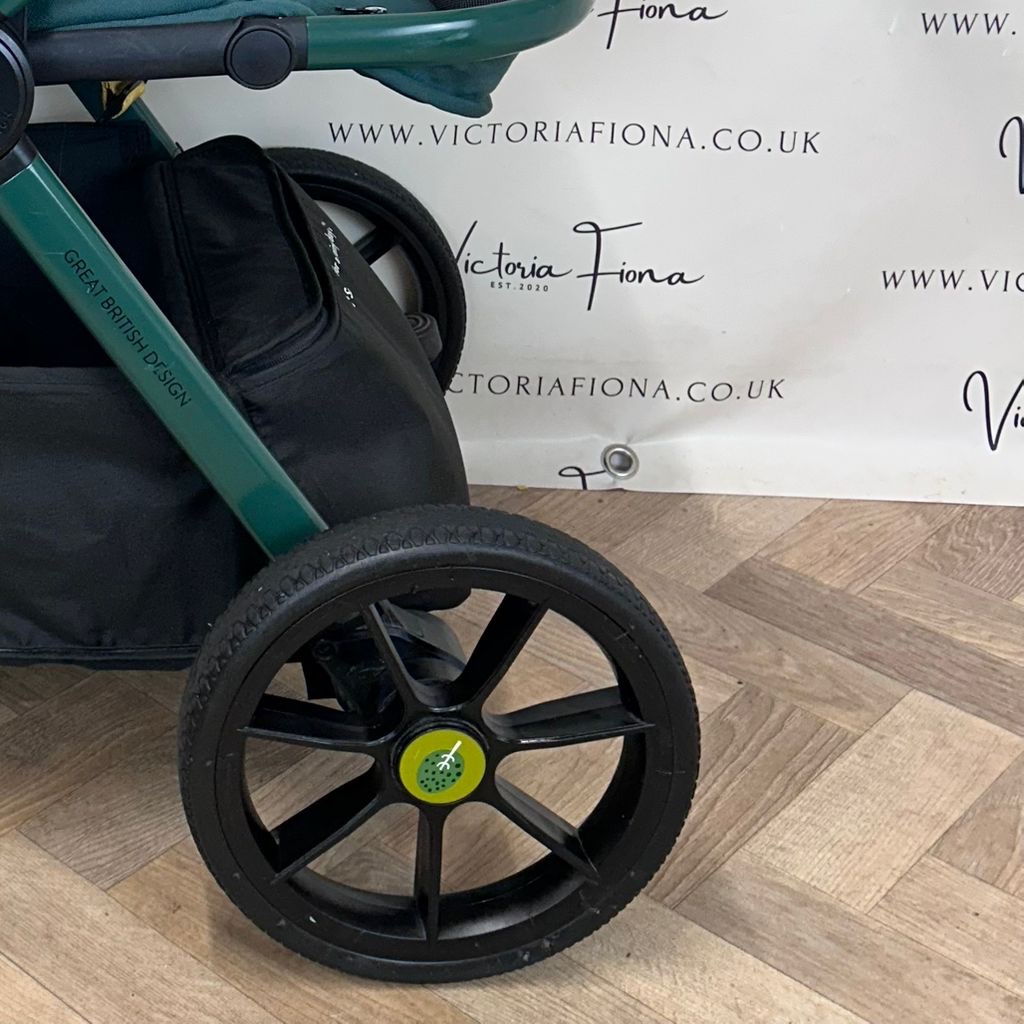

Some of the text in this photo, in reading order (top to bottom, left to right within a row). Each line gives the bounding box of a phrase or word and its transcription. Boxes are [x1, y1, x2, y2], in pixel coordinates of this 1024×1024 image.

[328, 120, 821, 155] WWW.VICTORIAFIONA.CO.UK
[490, 281, 550, 293] EST.2020
[573, 221, 705, 312] Fiona
[64, 249, 192, 407] GREAT BRITISH DESIGN
